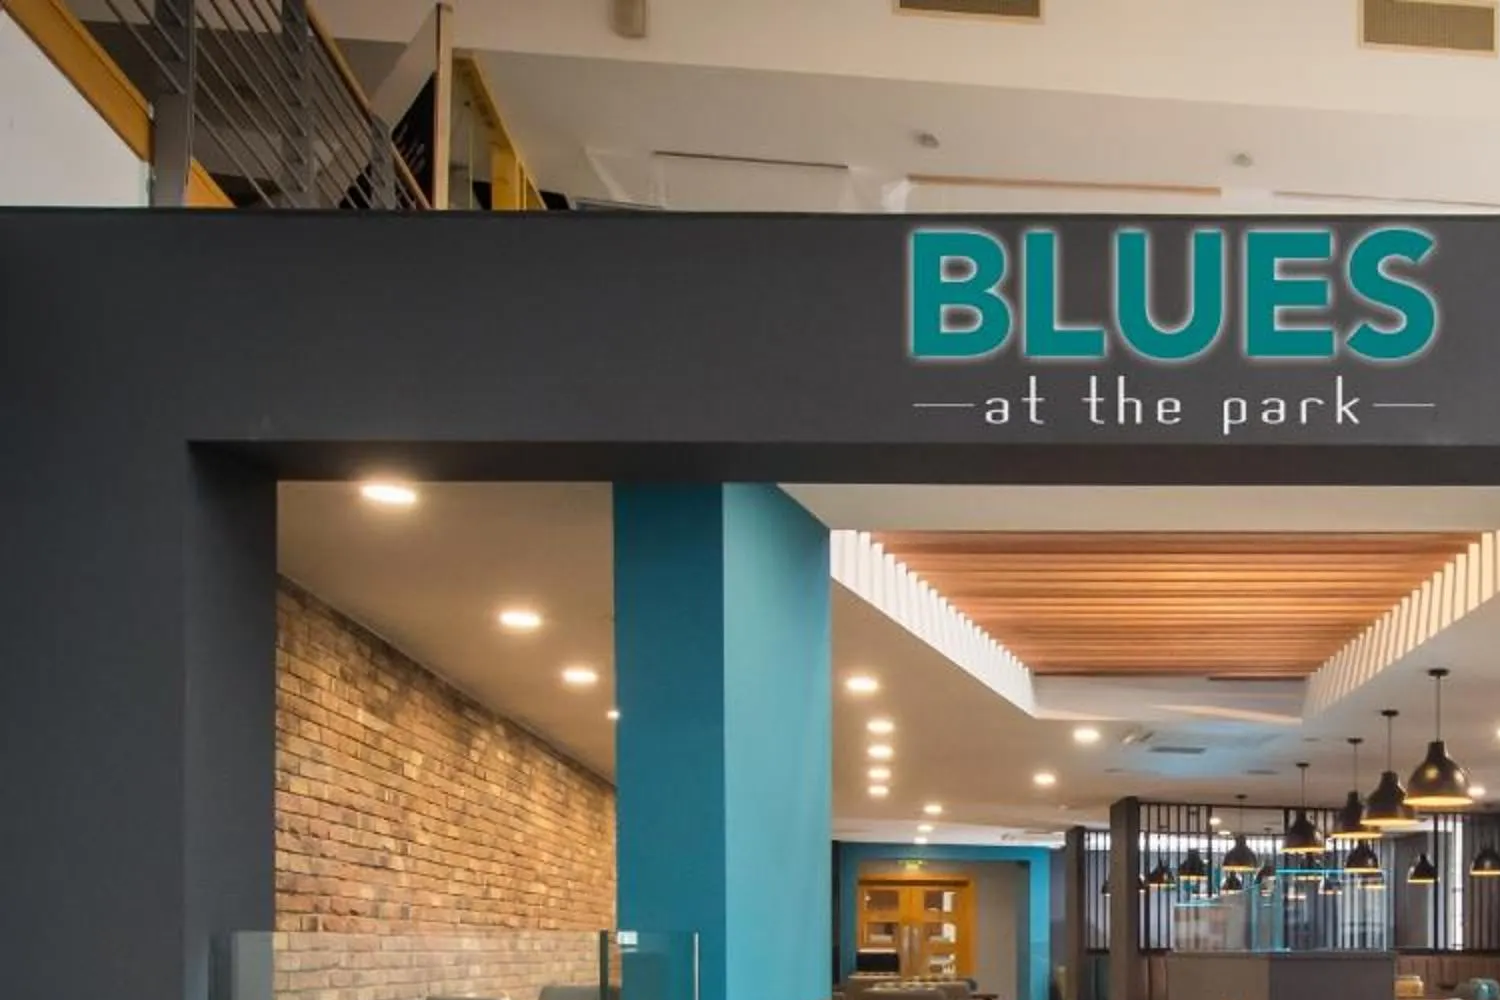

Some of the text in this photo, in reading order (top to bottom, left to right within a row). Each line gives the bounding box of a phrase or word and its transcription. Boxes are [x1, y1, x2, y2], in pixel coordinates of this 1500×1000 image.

[910, 228, 1437, 360] BLUES
[984, 374, 1361, 436] at the park
